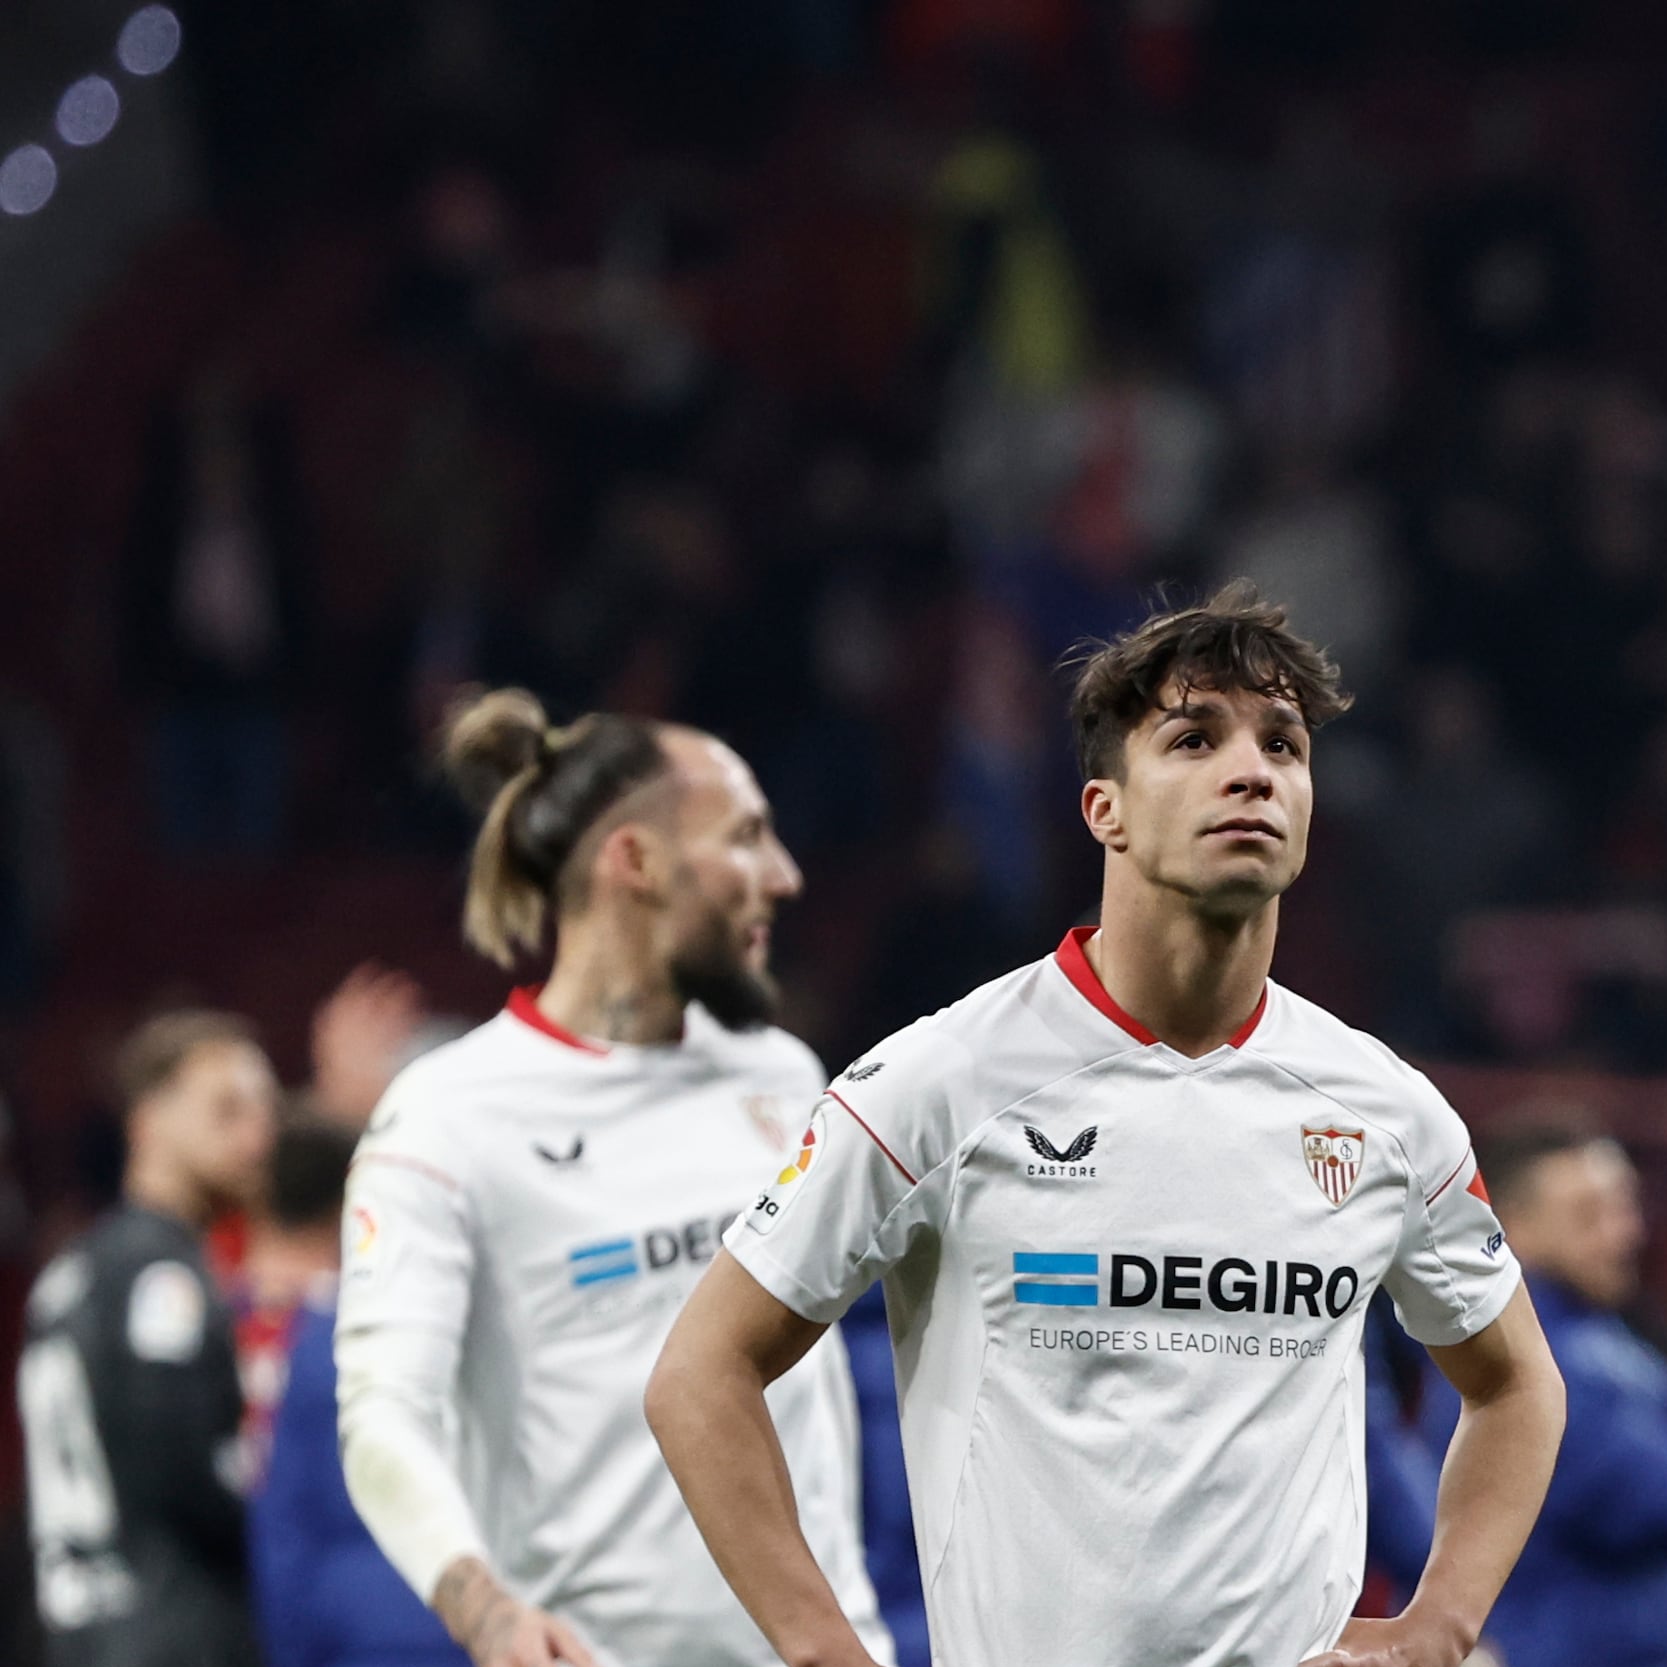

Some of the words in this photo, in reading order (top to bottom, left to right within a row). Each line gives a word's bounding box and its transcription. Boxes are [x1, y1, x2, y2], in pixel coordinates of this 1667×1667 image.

[1028, 1164, 1097, 1177] CASTORE
[1110, 1253, 1359, 1319] DEGIRO
[1030, 1328, 1148, 1351] EUROPE'S
[1156, 1332, 1260, 1356] LEADING
